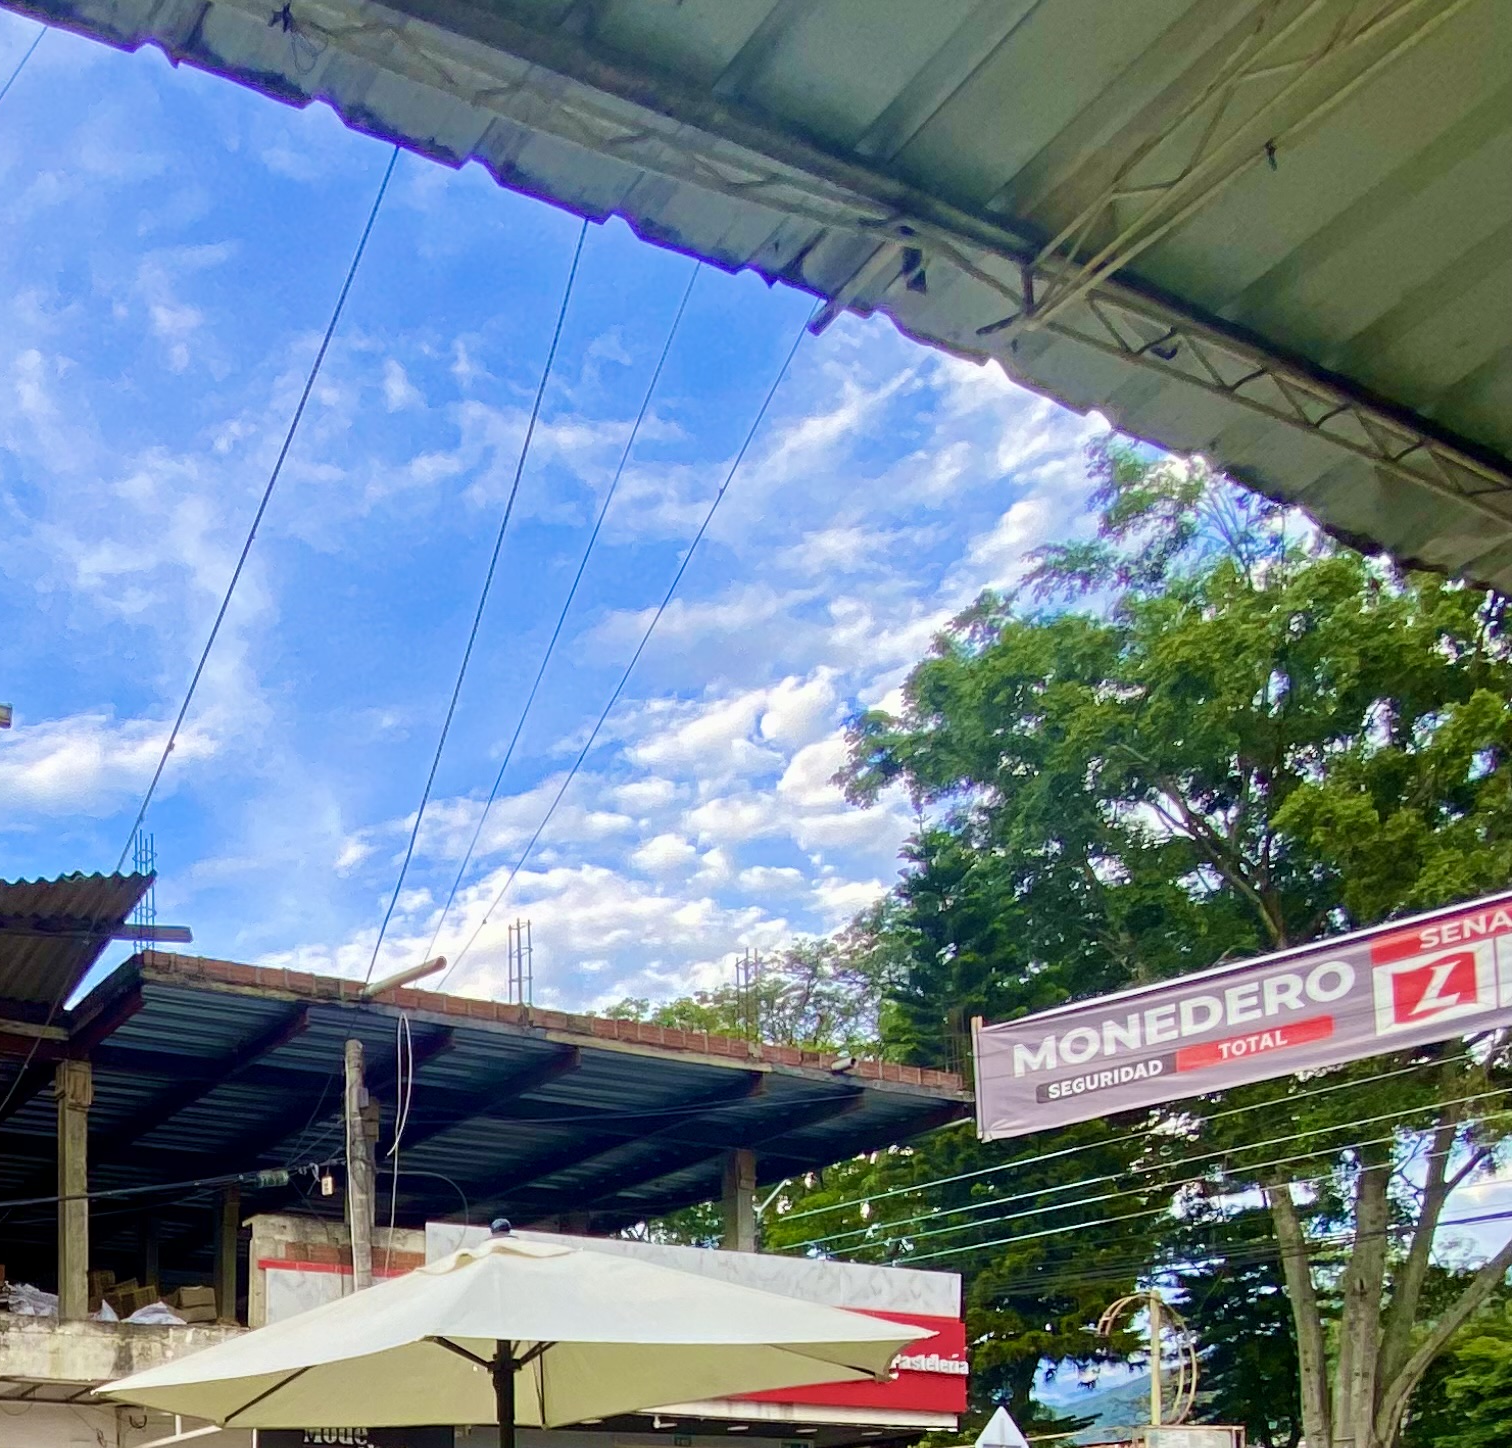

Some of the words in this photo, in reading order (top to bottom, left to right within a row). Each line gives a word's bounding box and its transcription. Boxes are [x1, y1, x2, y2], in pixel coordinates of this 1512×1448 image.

[1012, 960, 1356, 1078] MONEDERO
[1218, 1030, 1288, 1060] TOTAL
[1048, 1060, 1163, 1100] SEGURIDAD
